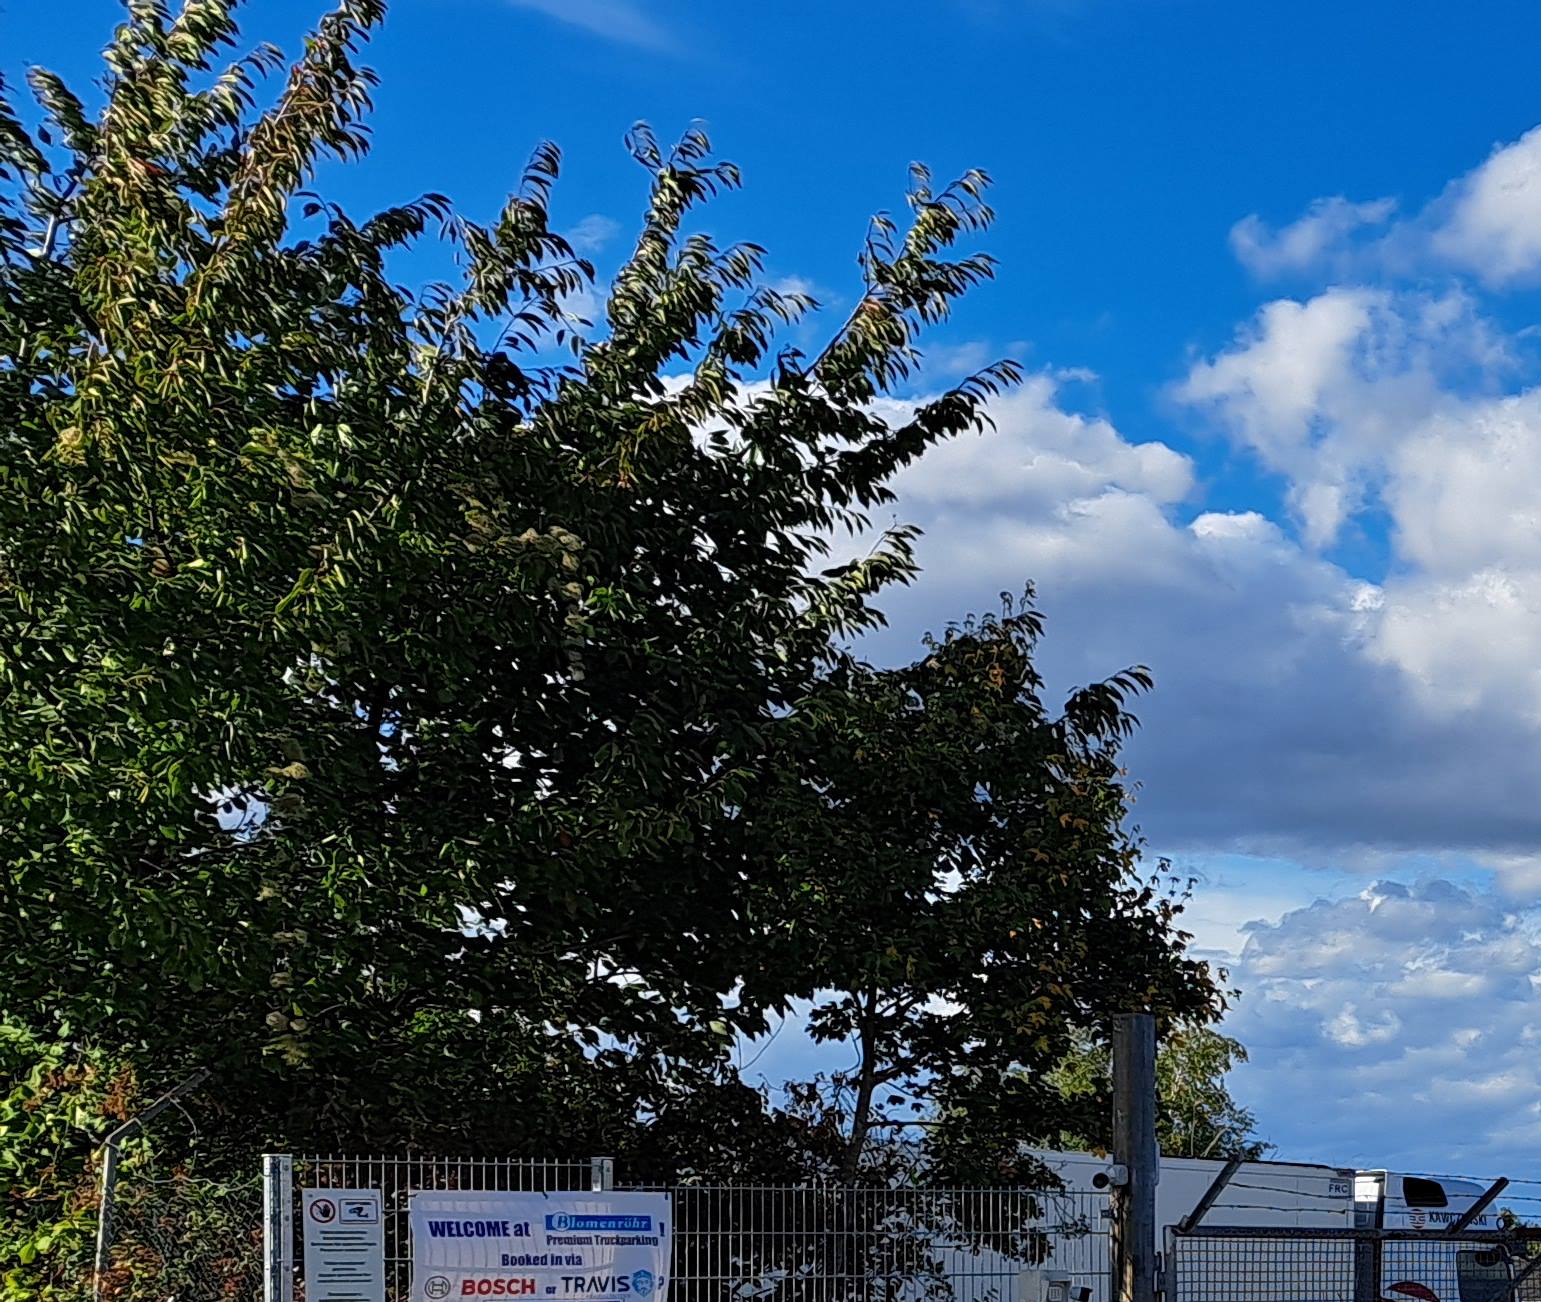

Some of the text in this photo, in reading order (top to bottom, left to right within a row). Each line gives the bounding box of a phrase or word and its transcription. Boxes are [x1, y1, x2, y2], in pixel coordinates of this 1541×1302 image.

[1328, 1184, 1348, 1194] FRC
[429, 1220, 510, 1238] WELCOME
[513, 1221, 531, 1238] at
[546, 1234, 659, 1247] Premium Truckparking
[501, 1253, 583, 1267] Booked in via
[461, 1278, 536, 1297] BOSCH
[545, 1286, 557, 1296] or
[561, 1275, 631, 1294] TRAVIS
